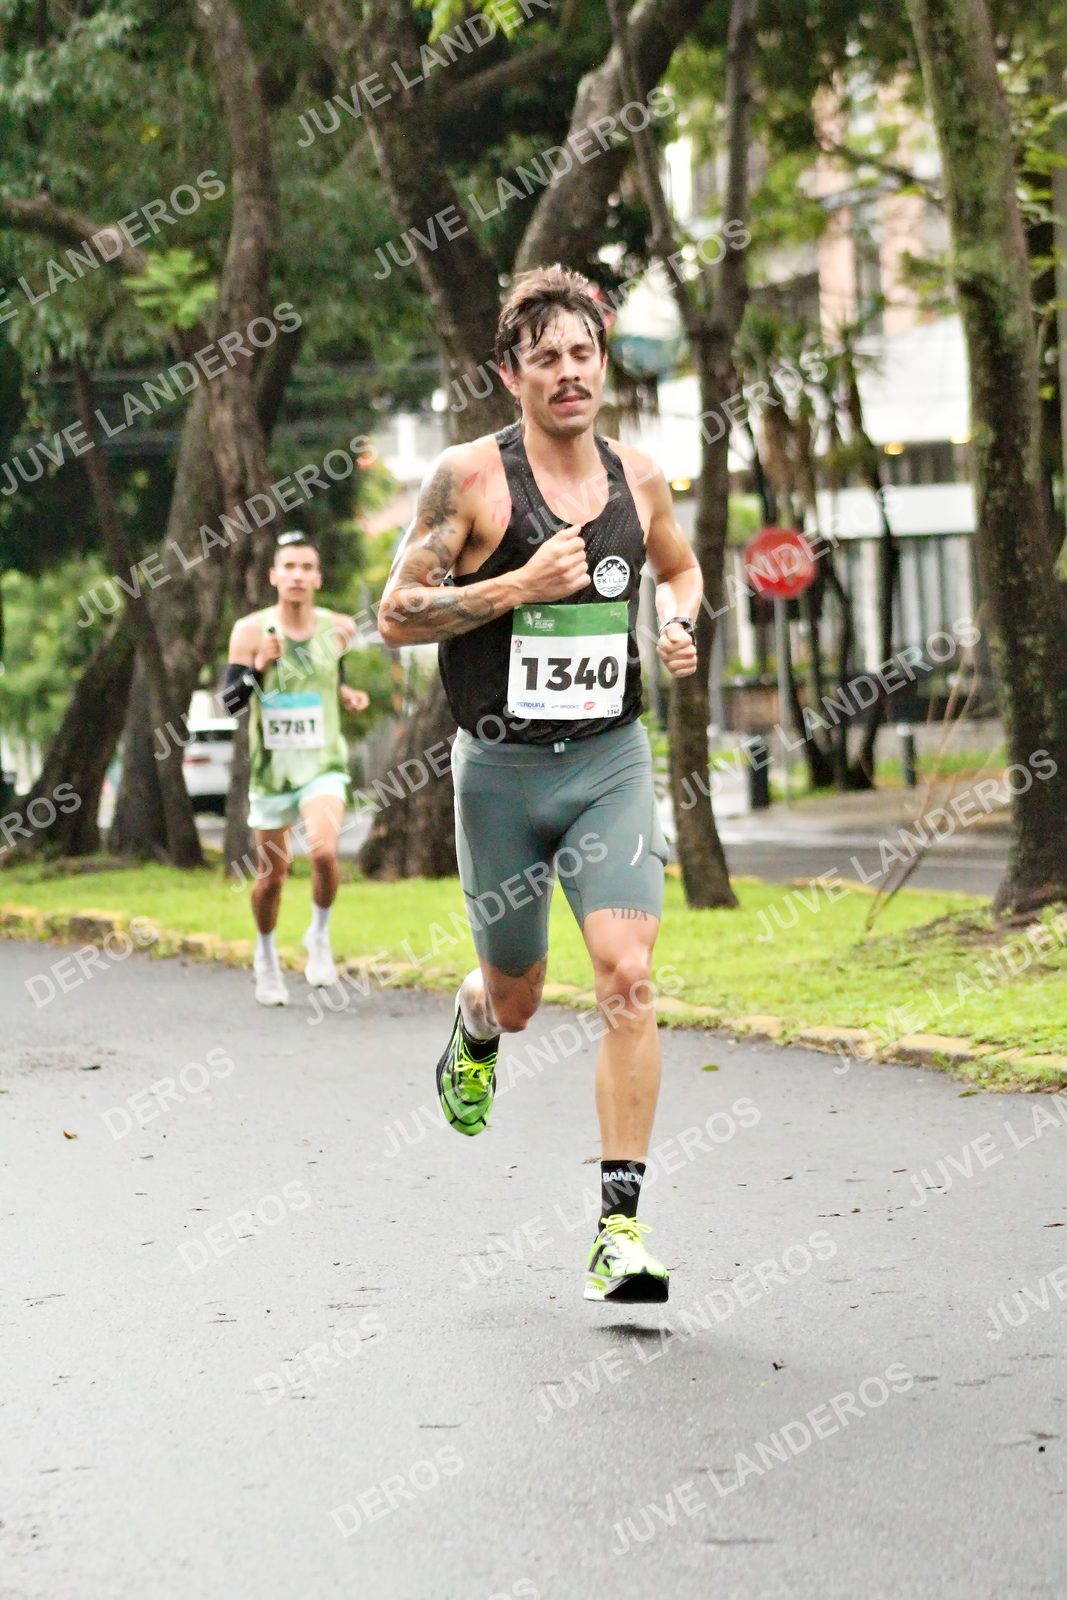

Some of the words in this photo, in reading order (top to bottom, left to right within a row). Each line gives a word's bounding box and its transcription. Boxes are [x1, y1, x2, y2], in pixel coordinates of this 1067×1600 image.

[596, 576, 627, 584] SKILLS
[521, 655, 619, 691] 1340
[268, 719, 315, 736] 5781
[610, 907, 648, 921] VIDA
